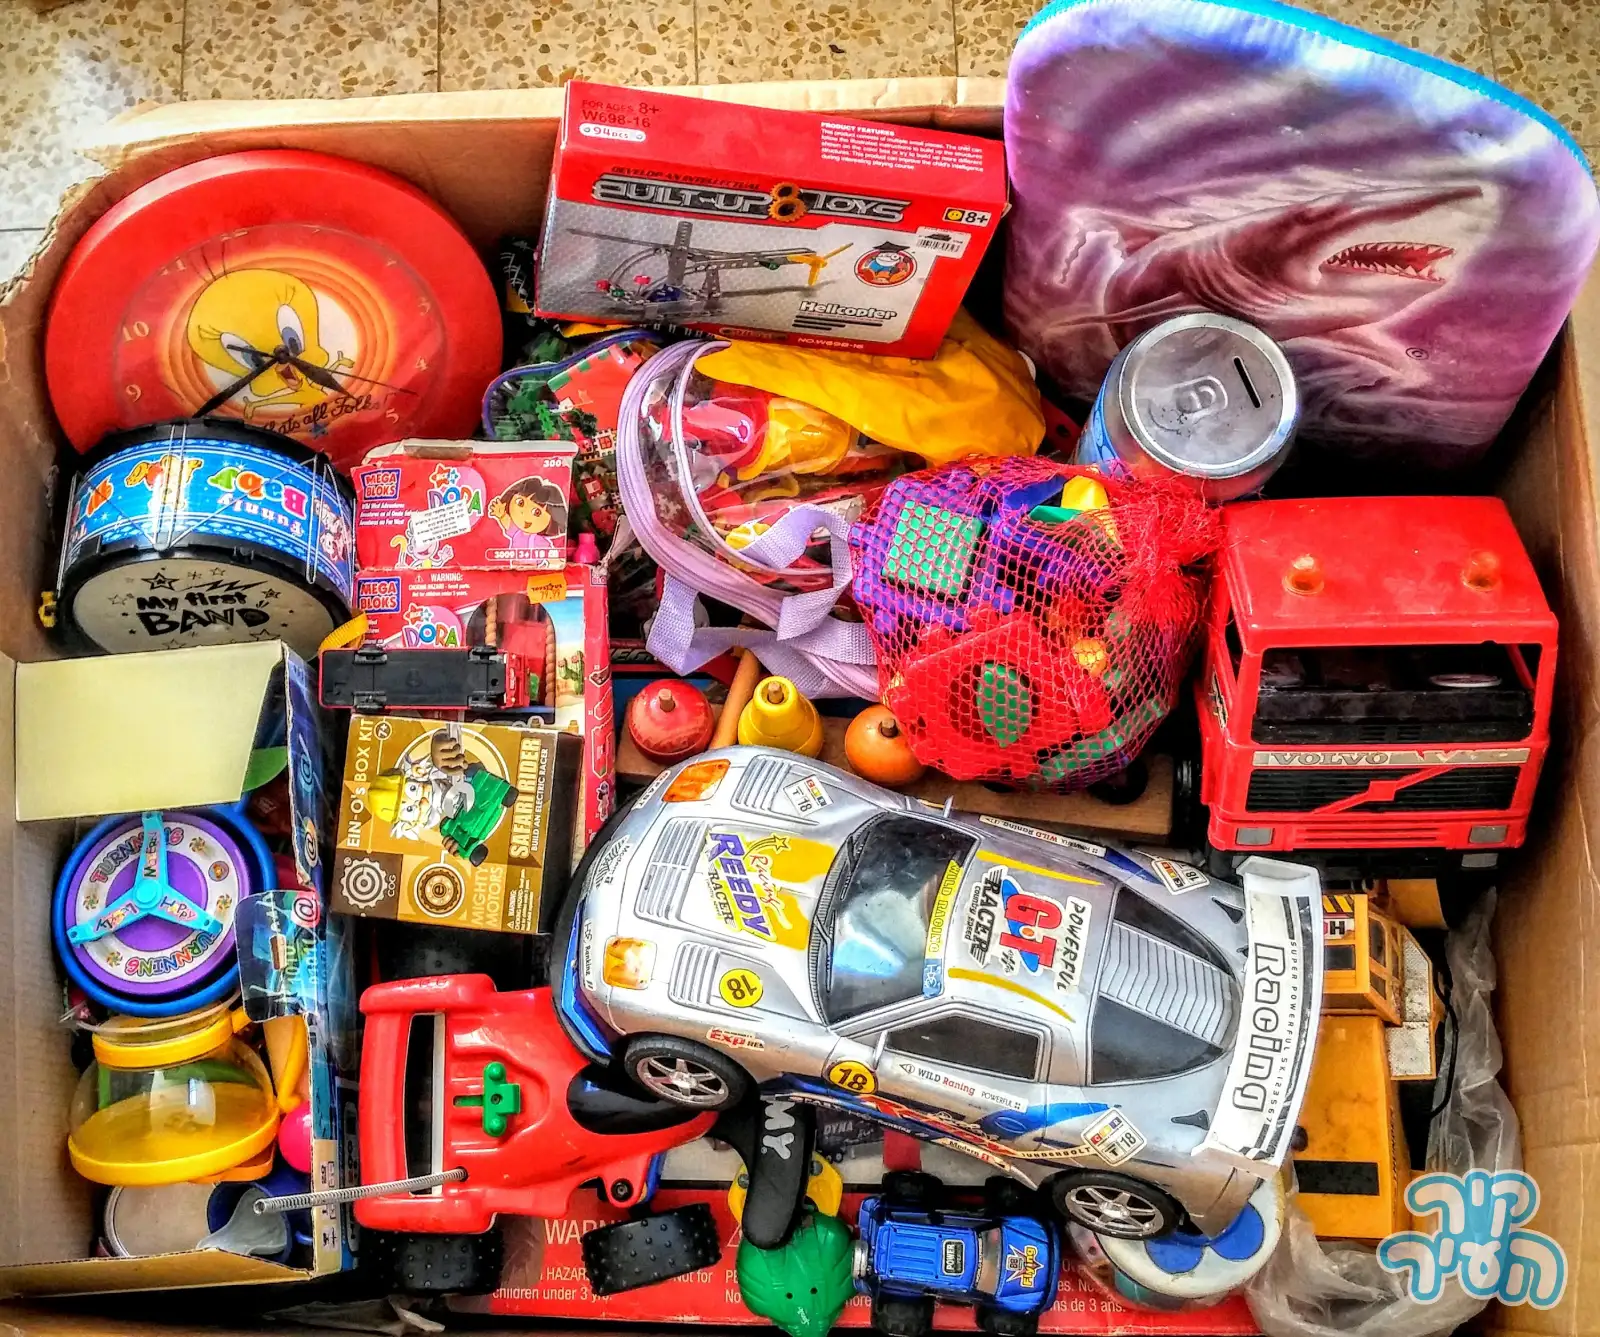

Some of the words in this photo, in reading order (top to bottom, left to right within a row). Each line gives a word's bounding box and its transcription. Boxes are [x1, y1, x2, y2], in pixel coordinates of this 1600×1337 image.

[582, 109, 651, 128] W698-16
[638, 102, 660, 115] 8+
[821, 122, 856, 131] PRODUCT
[857, 127, 895, 136] FEATURES
[811, 189, 906, 222] TOYS
[965, 209, 989, 225] 8+
[801, 301, 897, 319] Helicopter
[121, 320, 150, 342] 10
[414, 356, 428, 373] 4
[125, 384, 142, 402] 9
[385, 408, 400, 424] 5
[365, 472, 396, 484] MEGA
[366, 485, 395, 497] BLOKS
[217, 491, 305, 539] Funny
[360, 582, 397, 596] MEGA
[430, 573, 463, 582] WARNING:
[360, 596, 397, 609] BLOKS
[137, 607, 271, 636] BAND
[403, 622, 458, 648] DORA
[359, 719, 374, 741] KIT
[377, 723, 388, 738] 7+
[353, 746, 370, 782] BOX
[519, 737, 542, 793] RIDER
[539, 748, 549, 777] RACER
[1271, 751, 1390, 765] VOLVO
[535, 778, 546, 817] ELECTRIC
[800, 801, 813, 814] 18
[346, 787, 368, 848] EIN-O's
[509, 796, 537, 859] SAFARI
[533, 819, 541, 830] AN
[530, 830, 541, 852] BUILD
[1035, 828, 1058, 843] WILD
[387, 874, 397, 897] COG
[703, 832, 772, 937] REEDY
[749, 854, 780, 906] Racing
[942, 863, 963, 897] WILD
[1186, 871, 1199, 881] 18
[472, 867, 489, 924] MIGHTY
[486, 866, 504, 928] MOTORS
[709, 868, 736, 925] RACER
[969, 886, 981, 915] country
[928, 900, 949, 953] RACING
[971, 877, 1001, 954] RACER
[964, 916, 975, 941] speed
[1000, 893, 1062, 968] GT
[1057, 900, 1086, 990] POWERFUL
[1288, 941, 1298, 980] SUPER
[726, 974, 758, 1000] 18
[1231, 941, 1287, 1113] Racing
[1282, 985, 1297, 1050] POWERFUL
[838, 1068, 869, 1091] 18
[918, 1068, 941, 1083] WILD
[942, 1077, 976, 1096] Raning
[981, 1091, 1013, 1108] POWERFUL
[1120, 1132, 1137, 1149] 18
[945, 1244, 955, 1271] POWER
[1022, 1245, 1039, 1287] Flying
[546, 1267, 589, 1281] HAZAR
[696, 1269, 713, 1283] for
[543, 1287, 577, 1300] under
[580, 1286, 588, 1300] 3
[1070, 1298, 1085, 1312] de
[1089, 1298, 1097, 1311] 3
[1100, 1300, 1126, 1312] ans.
